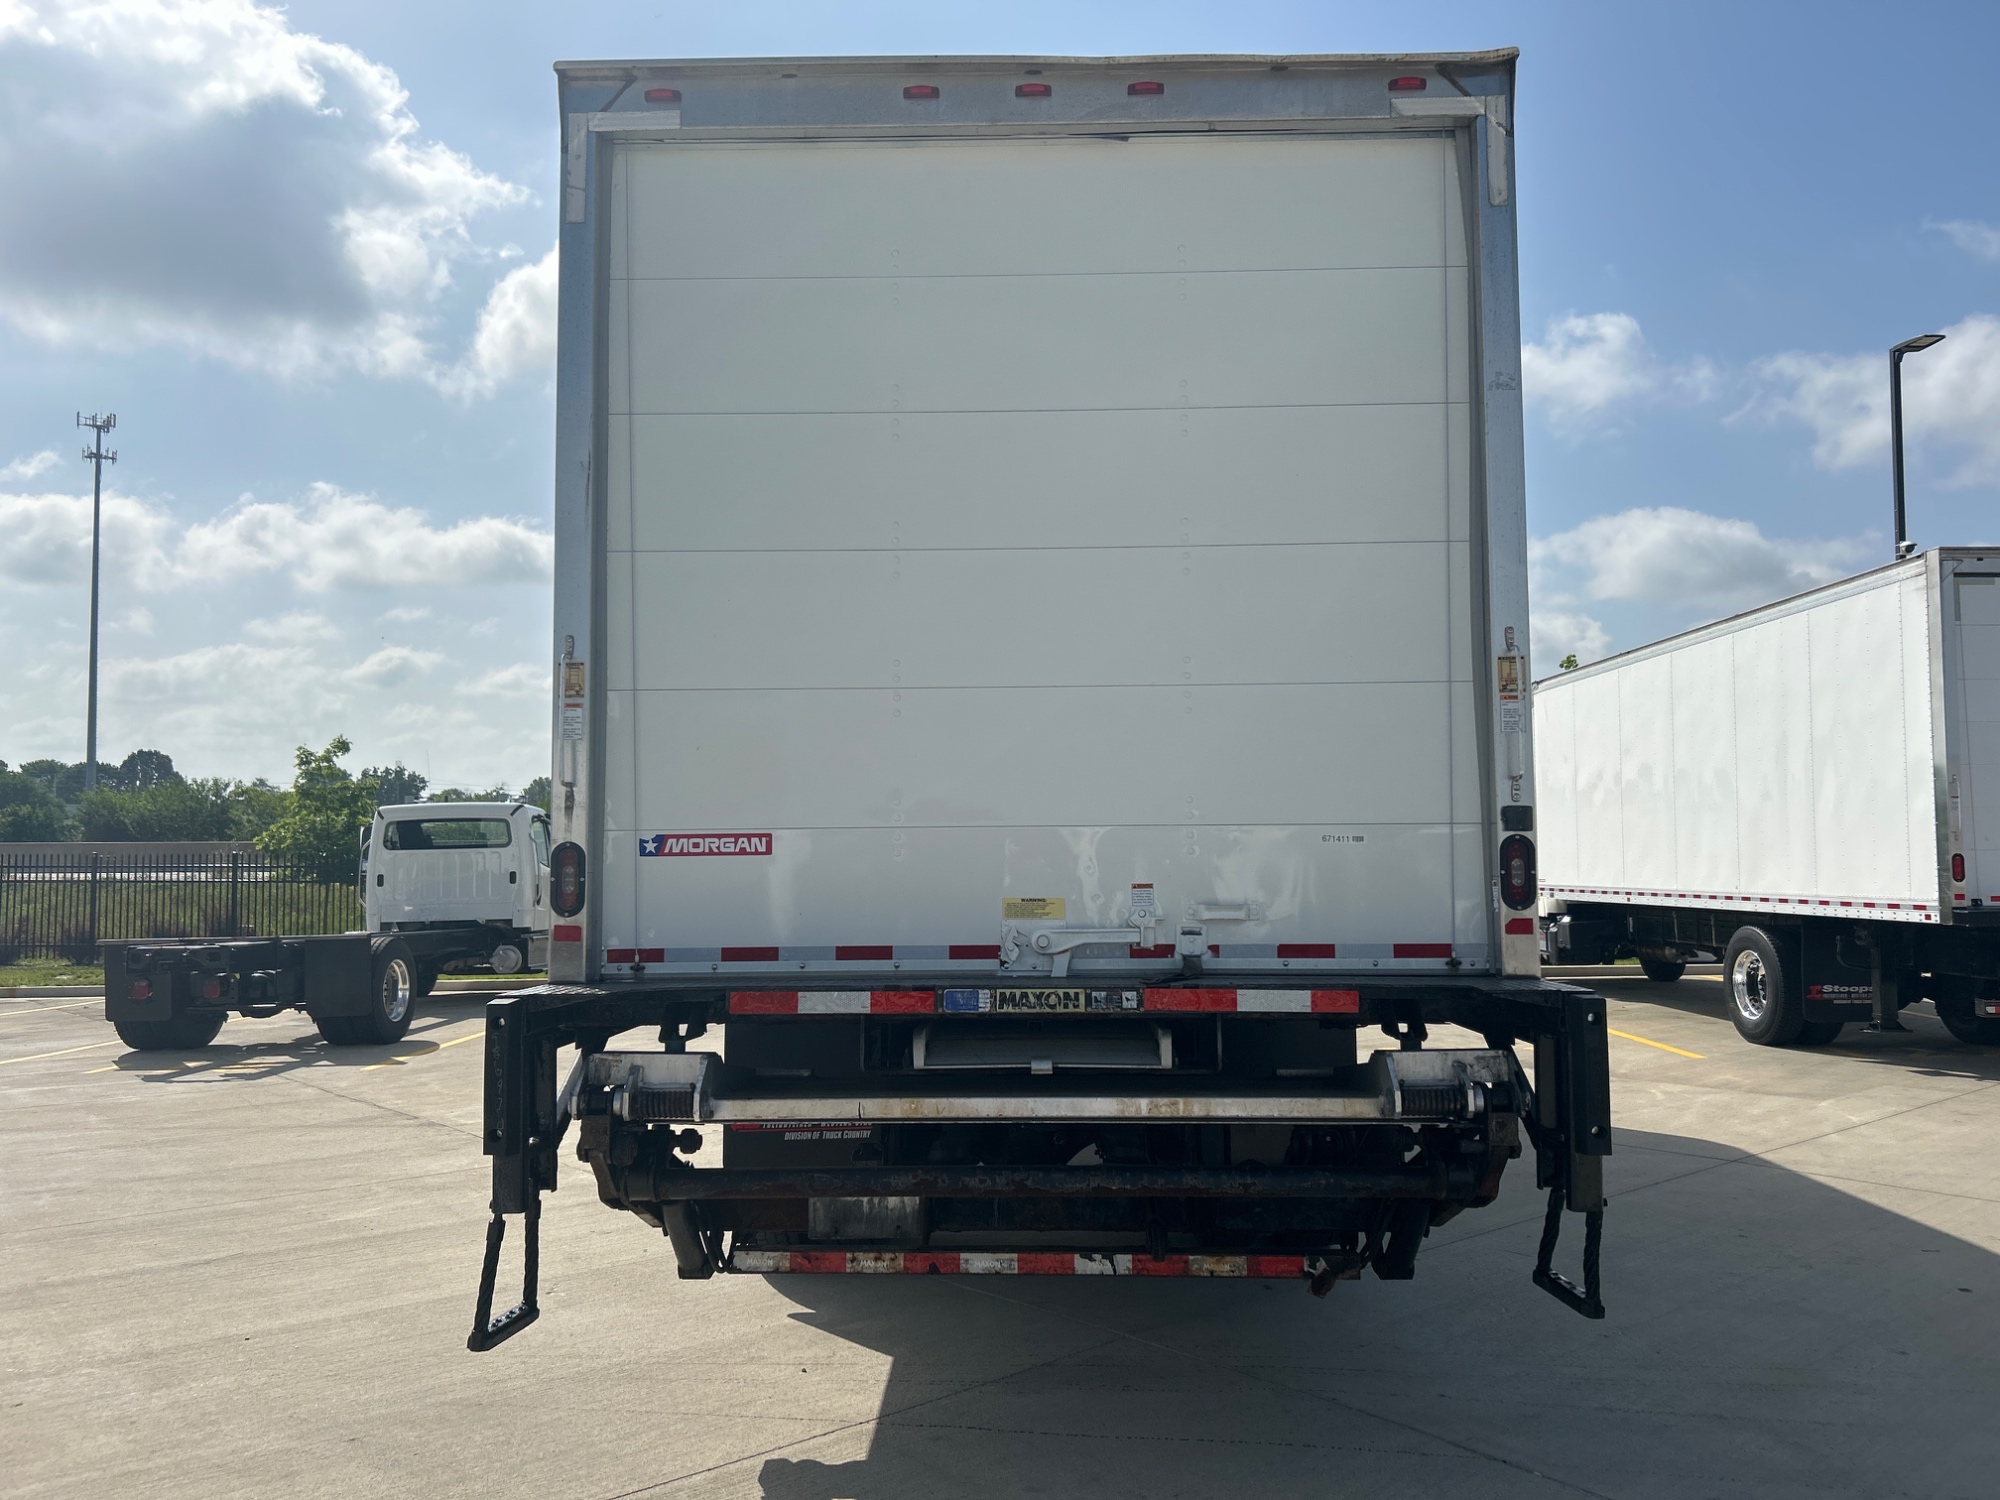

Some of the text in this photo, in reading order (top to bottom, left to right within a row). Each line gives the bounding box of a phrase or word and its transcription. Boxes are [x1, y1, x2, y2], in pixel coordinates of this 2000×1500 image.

[1321, 834, 1350, 843] 671411
[664, 837, 767, 853] MORGAN
[997, 991, 1081, 1011] MAXON
[784, 1130, 872, 1141] DIVISION OF TRUCK COUNTRY
[746, 1257, 774, 1266] MAXON
